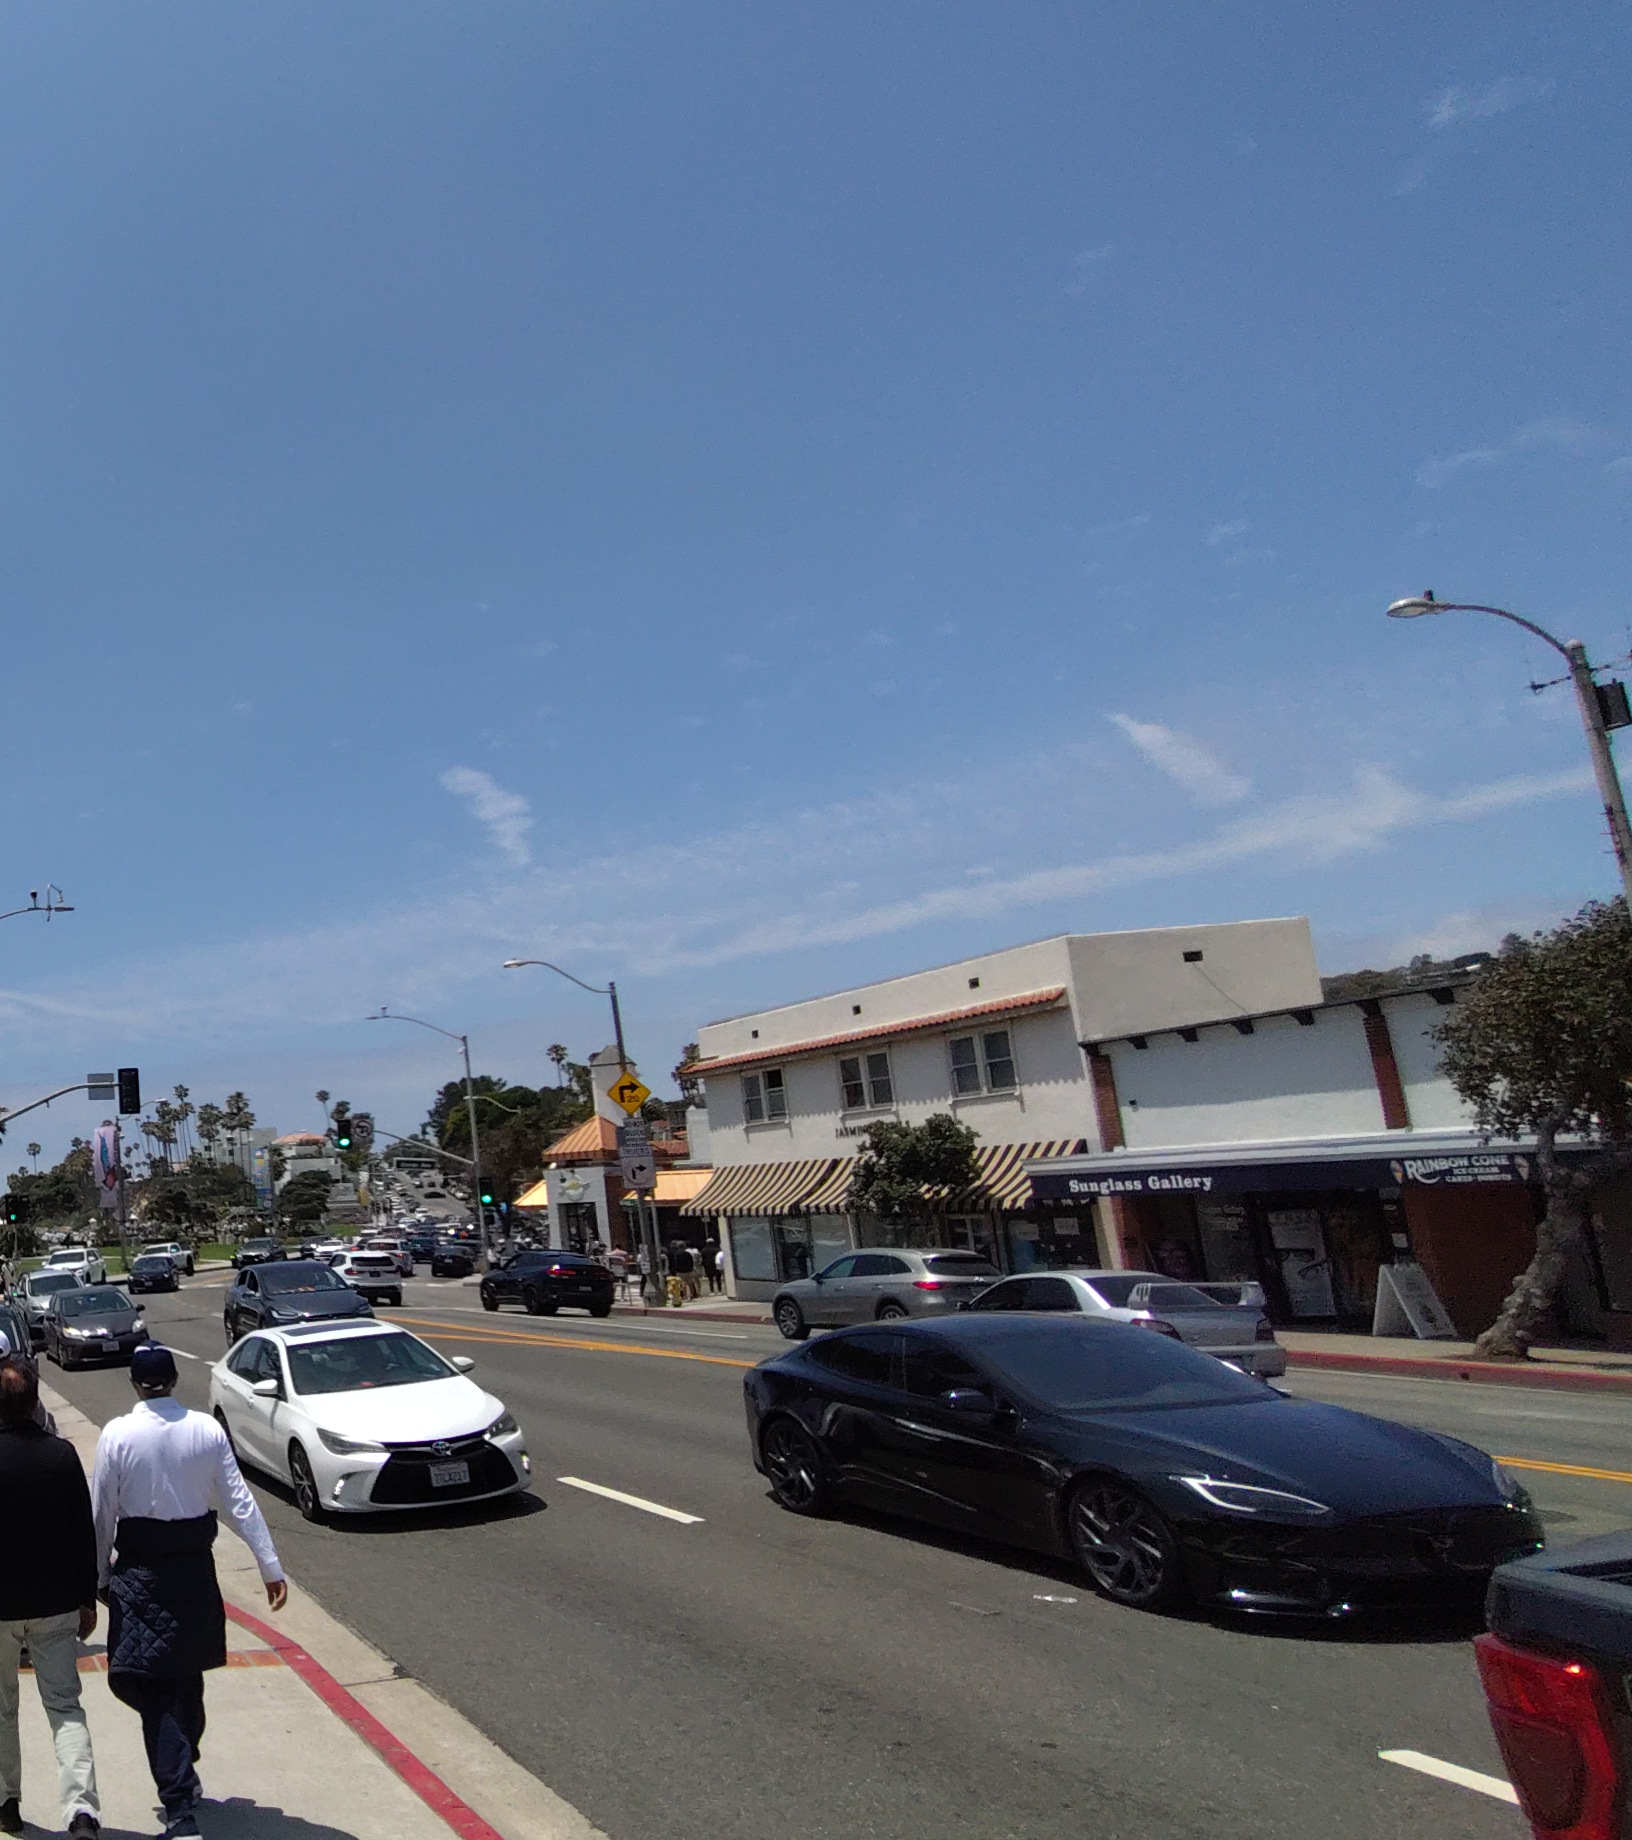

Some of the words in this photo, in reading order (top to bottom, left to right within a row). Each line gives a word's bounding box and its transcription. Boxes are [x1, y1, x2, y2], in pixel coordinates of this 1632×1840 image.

[1403, 1155, 1469, 1184] RAINBOW
[1471, 1155, 1510, 1167] CONE
[1069, 1178, 1143, 1195] Sunglass
[1147, 1174, 1212, 1191] Gallery
